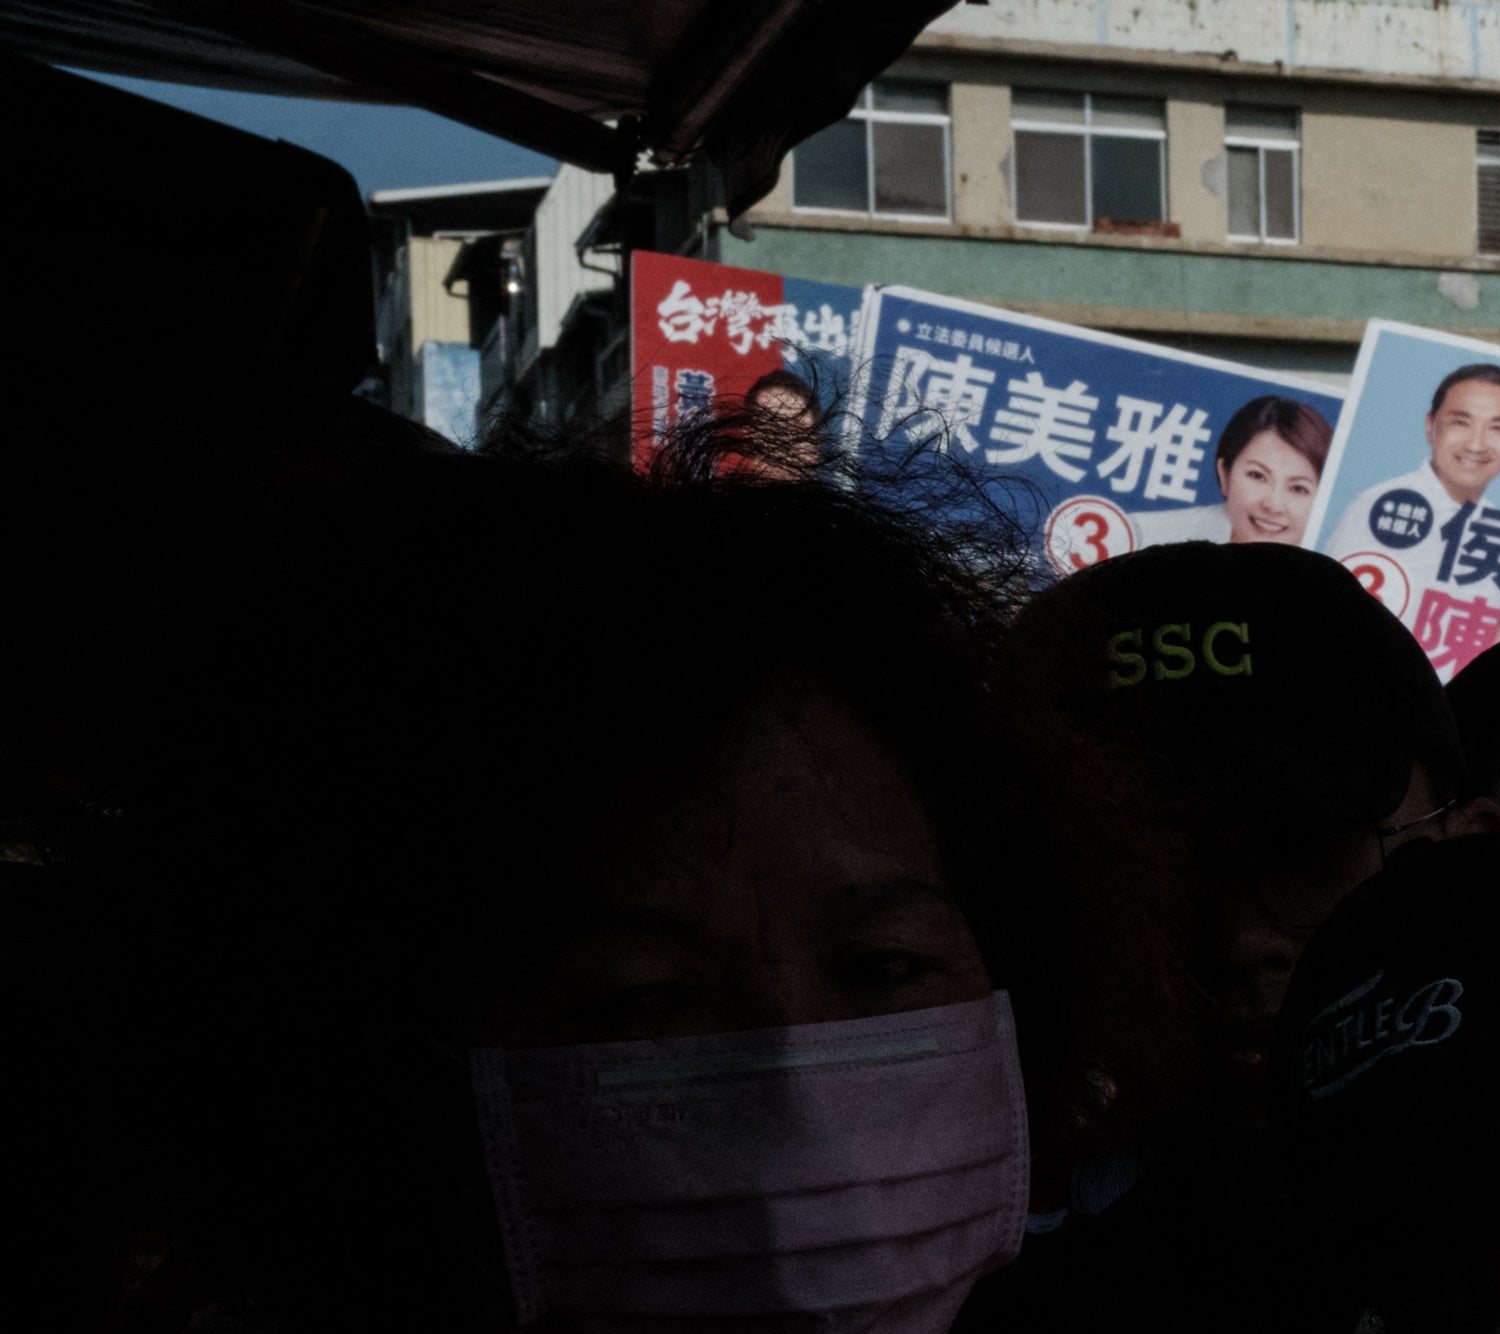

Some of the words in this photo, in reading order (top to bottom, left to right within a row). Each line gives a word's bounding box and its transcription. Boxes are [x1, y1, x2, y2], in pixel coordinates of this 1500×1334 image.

[657, 279, 860, 362] 台灣再出
[876, 345, 1212, 503] 陳美雅
[1071, 511, 1111, 569] 3
[1107, 620, 1253, 688] SSC
